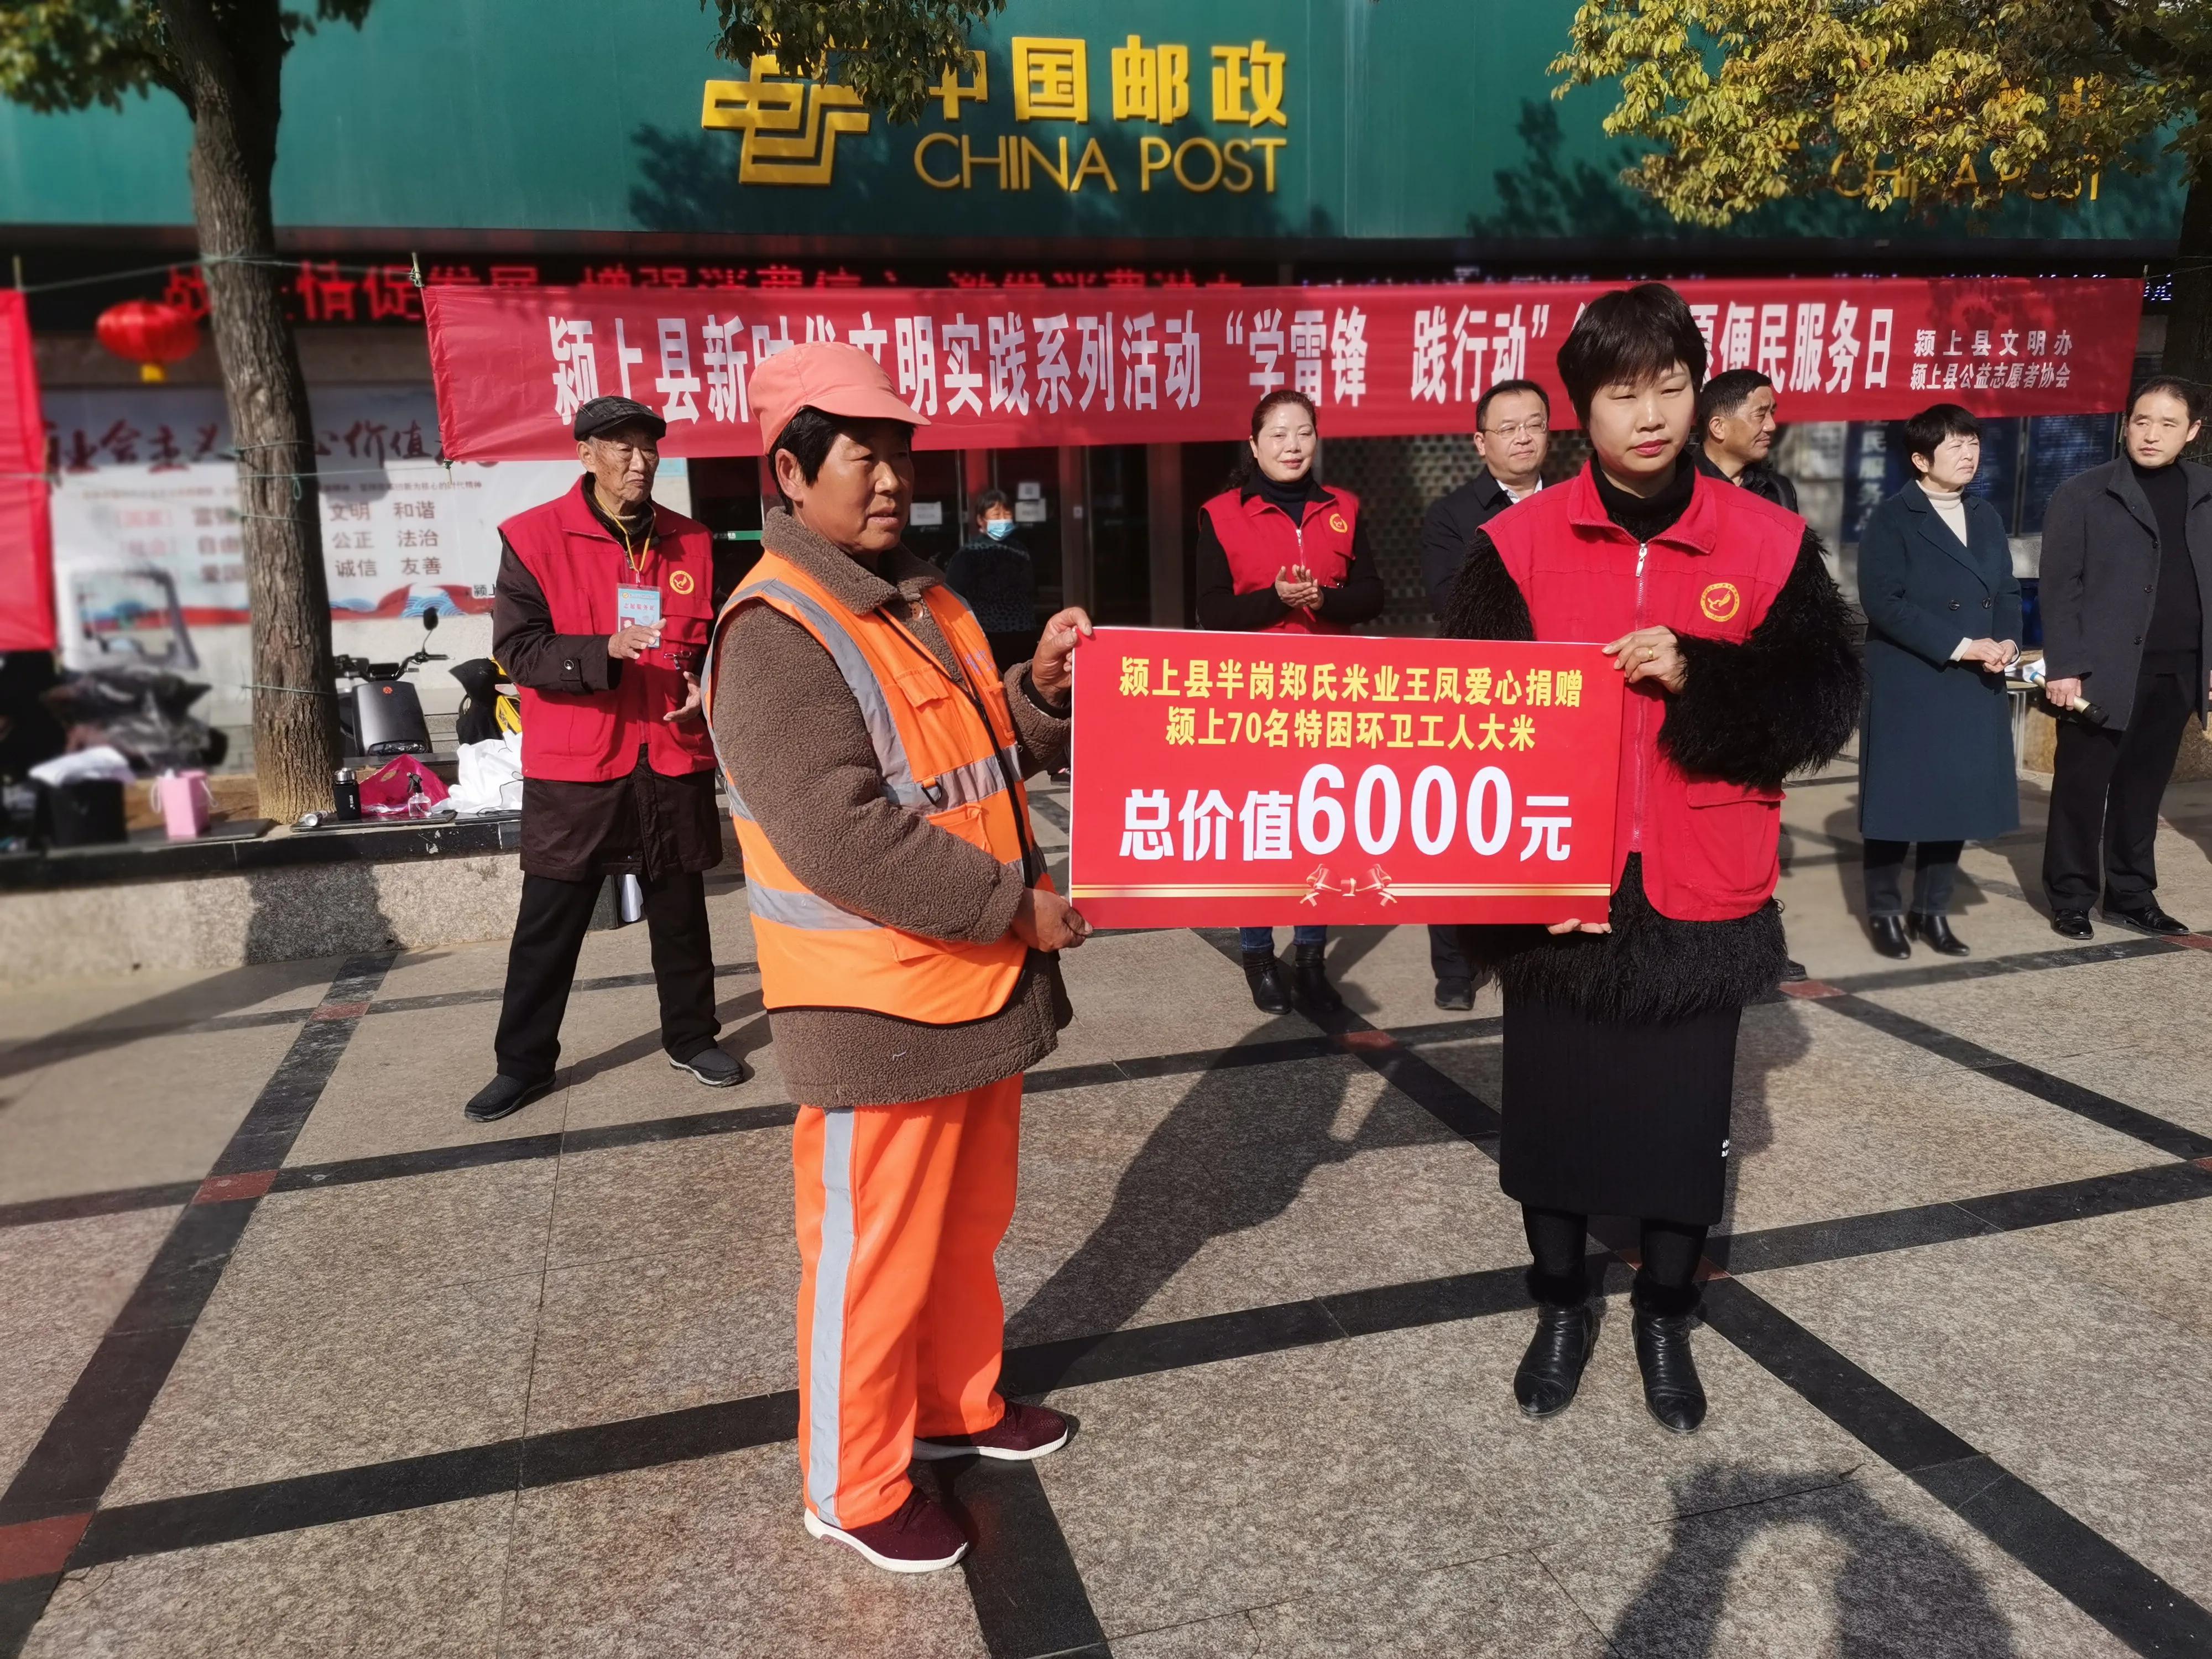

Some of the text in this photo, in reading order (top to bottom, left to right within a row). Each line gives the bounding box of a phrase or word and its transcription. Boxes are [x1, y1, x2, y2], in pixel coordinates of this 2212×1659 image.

[914, 132, 1287, 193] CHINA POST
[1913, 328, 2073, 357] 颍上县文明办
[1910, 362, 2071, 390] 颍上县公益志愿者协会
[330, 500, 435, 521] 文明 和谐
[332, 529, 439, 549] 公正 法治
[335, 556, 442, 578] 诚信 友善
[1119, 656, 1584, 708] 颍上县半岗郑氏米业王凤爱心捐赠
[1165, 706, 1536, 752] 颍上70名特困环卫工人大米
[1119, 763, 1573, 862] 总价值6000元
